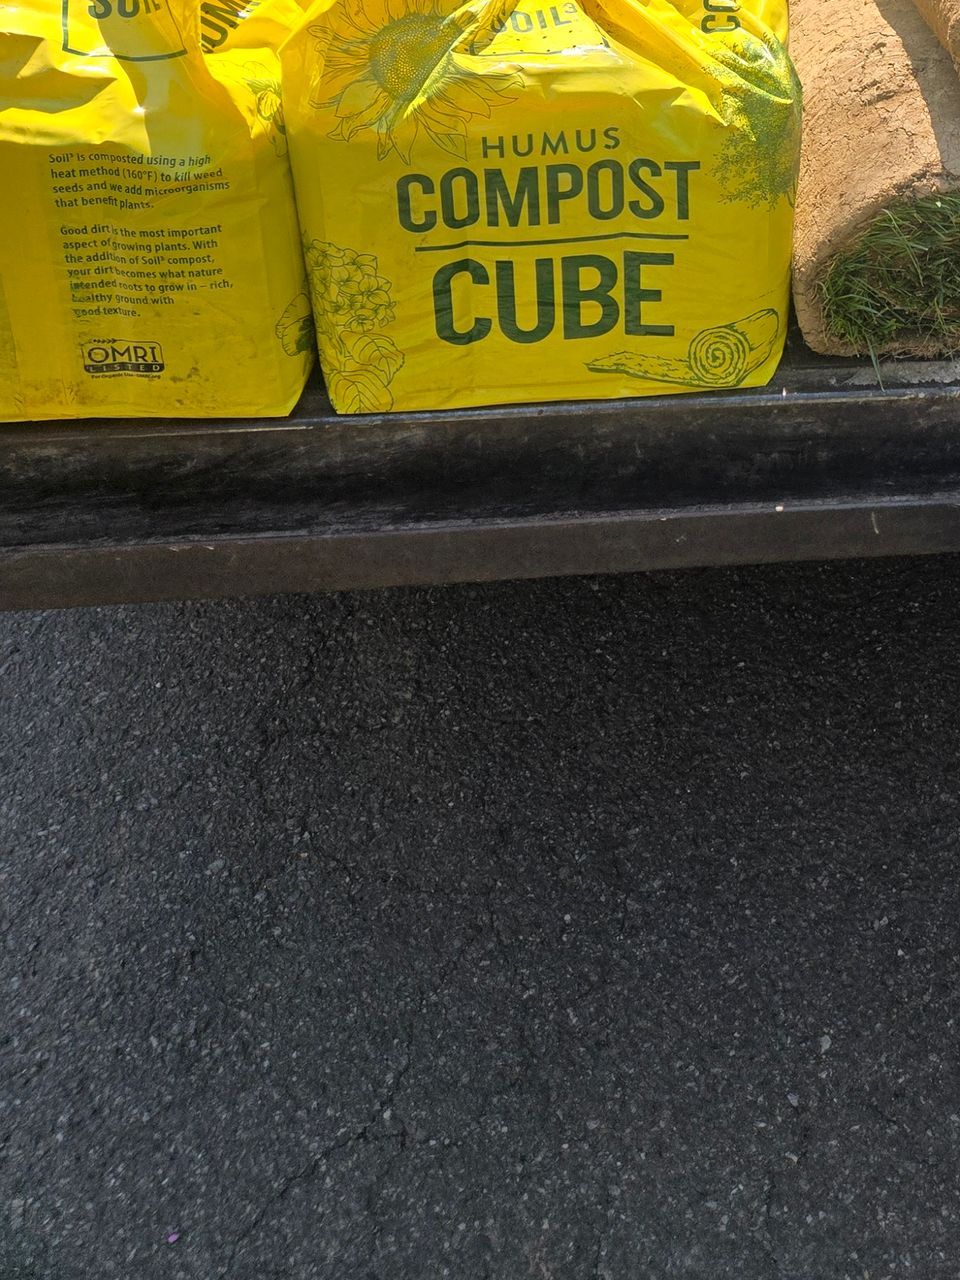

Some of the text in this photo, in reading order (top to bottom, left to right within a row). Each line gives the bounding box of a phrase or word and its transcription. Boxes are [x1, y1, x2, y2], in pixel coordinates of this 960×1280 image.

[481, 126, 622, 159] HUMUS
[77, 153, 85, 162] is
[88, 153, 144, 165] composted
[146, 157, 176, 168] using
[178, 158, 186, 167] a
[188, 155, 211, 168] high
[51, 165, 223, 183] heat method (160°F) to kill weed
[52, 180, 230, 196] seeds and we add microorganisms
[55, 195, 154, 210] that benefit plants.
[396, 158, 701, 234] COMPOST
[60, 225, 88, 236] Good
[91, 224, 110, 234] dirt
[119, 228, 137, 238] the
[139, 228, 165, 238] most
[167, 224, 223, 239] important
[63, 238, 218, 253] aspect of growing plants. With
[65, 254, 83, 263] the
[86, 252, 127, 264] addition
[129, 256, 140, 265] of
[167, 254, 215, 267] compost,
[67, 265, 223, 279] your dirt becomes what nature
[119, 282, 144, 292] roots
[145, 283, 156, 293] to
[158, 283, 184, 294] grow
[186, 282, 198, 291] in
[210, 279, 233, 290] rich,
[115, 294, 149, 305] ground
[150, 295, 175, 305] with
[432, 250, 675, 346] CUBE
[102, 307, 141, 318] texture.
[88, 345, 159, 363] OMRI
[90, 364, 160, 372] LISTED
